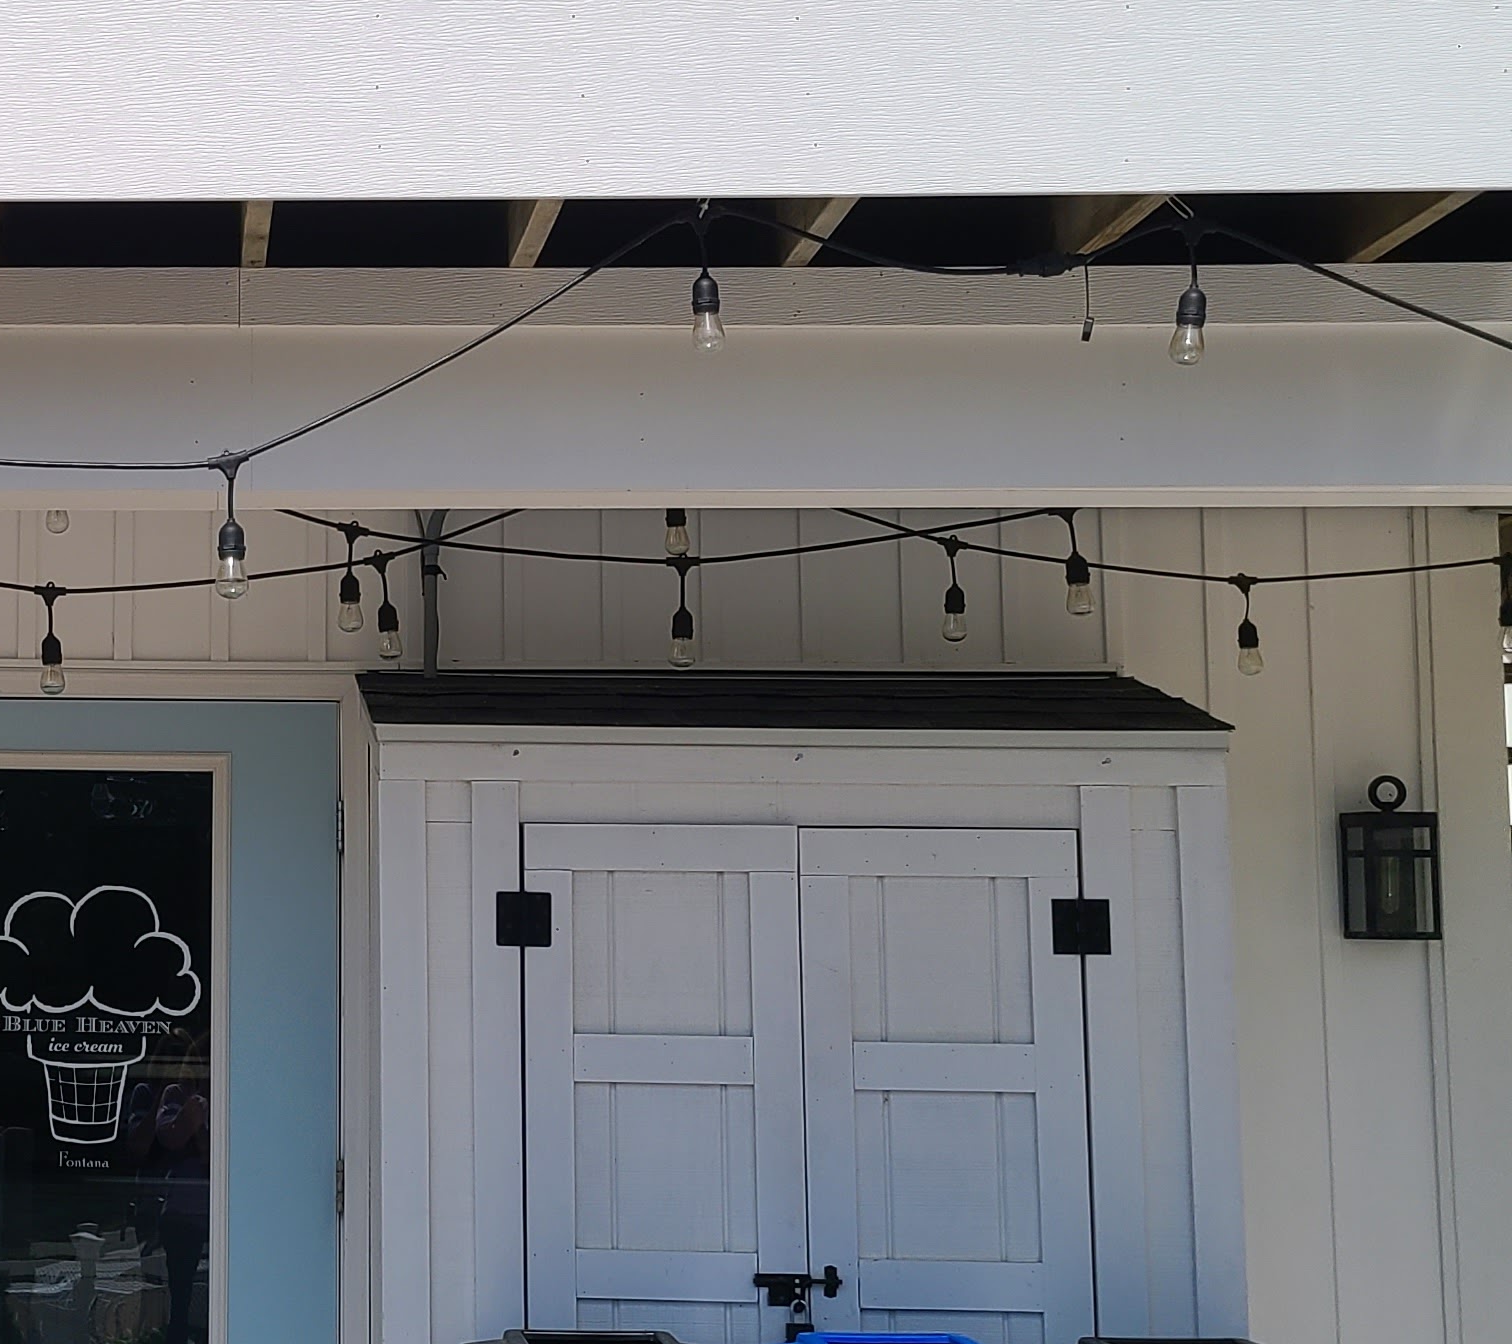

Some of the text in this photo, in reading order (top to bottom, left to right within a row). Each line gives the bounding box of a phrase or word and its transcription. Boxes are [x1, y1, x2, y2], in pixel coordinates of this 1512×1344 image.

[1, 1015, 172, 1035] BLUE HEAVEN
[48, 1036, 124, 1053] ice cream
[58, 1150, 110, 1169] Fontana
